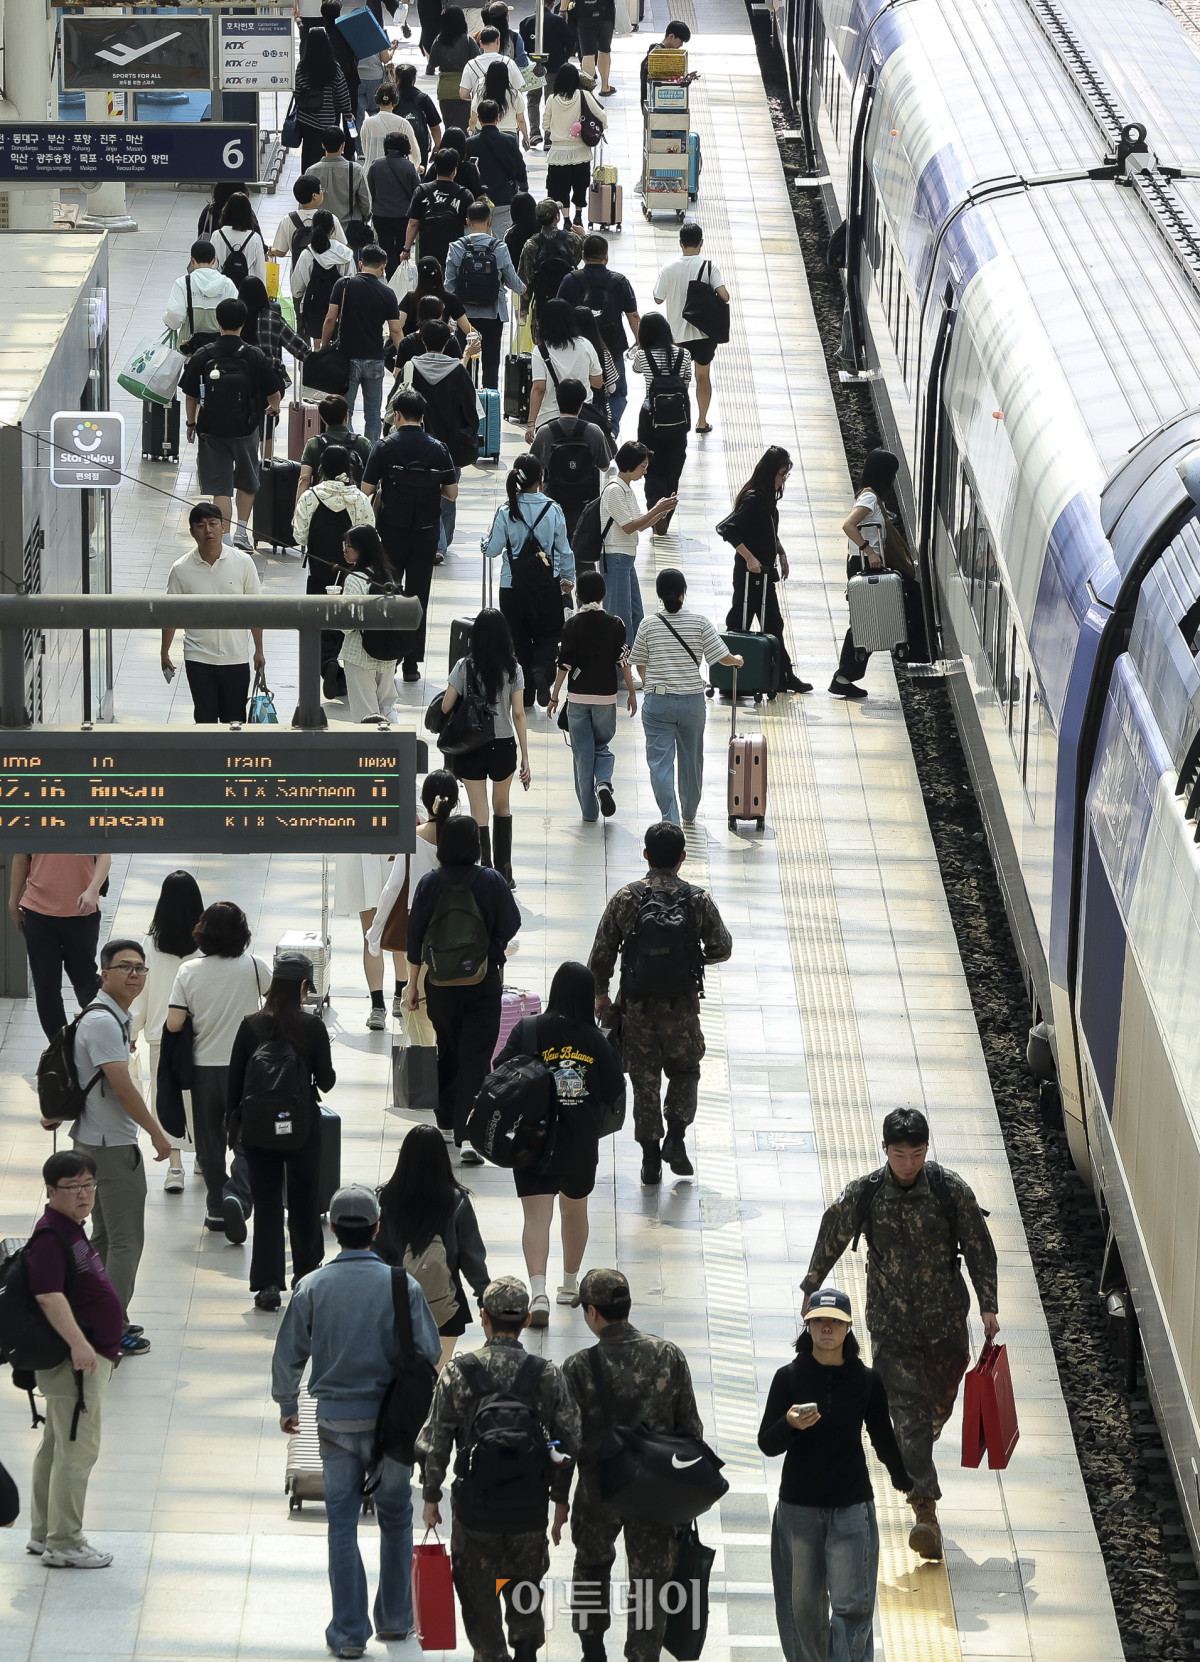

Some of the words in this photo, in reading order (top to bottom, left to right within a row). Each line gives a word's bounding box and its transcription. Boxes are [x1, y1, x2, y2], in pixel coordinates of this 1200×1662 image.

[226, 22, 255, 31] 호차번호
[225, 40, 248, 50] KTX
[13, 133, 39, 144] 동대구
[47, 134, 66, 144] 부산
[73, 134, 92, 145] 포항
[100, 134, 117, 145] 진주
[125, 134, 144, 145] 마산
[10, 153, 29, 164] 익산
[36, 153, 72, 164] 광주송정
[80, 153, 98, 164] 목포
[105, 154, 147, 164] 여수EXPO
[151, 154, 169, 165] 방면
[222, 138, 244, 169] 6
[60, 453, 115, 465] StoryWay
[75, 472, 100, 481] 편의점
[541, 1047, 559, 1062] New
[559, 1046, 596, 1065] Balance
